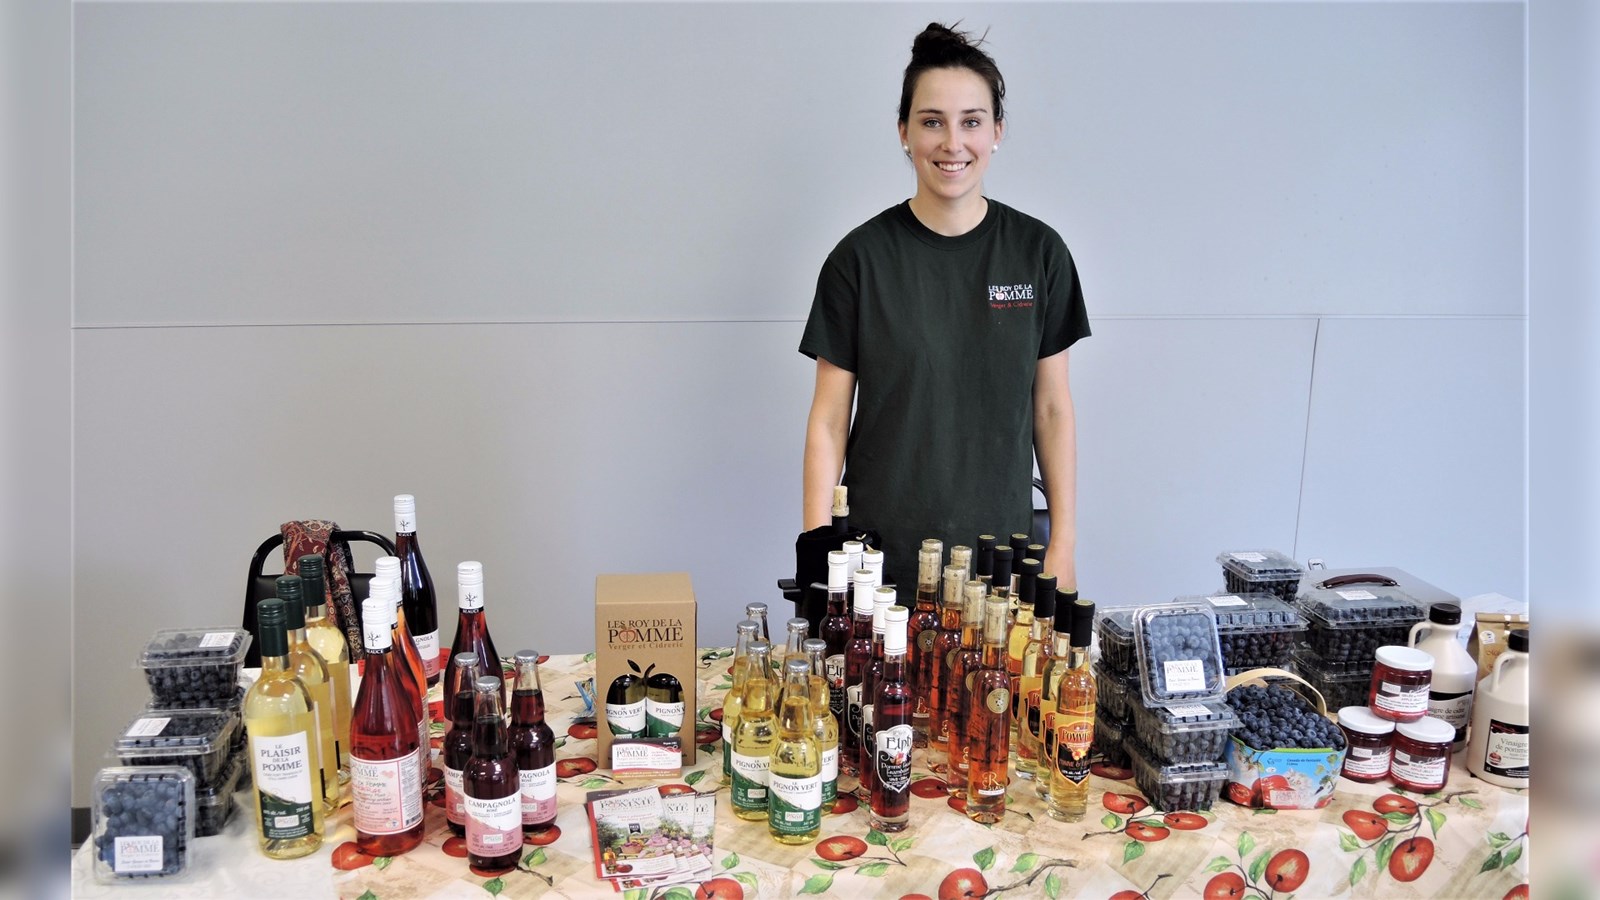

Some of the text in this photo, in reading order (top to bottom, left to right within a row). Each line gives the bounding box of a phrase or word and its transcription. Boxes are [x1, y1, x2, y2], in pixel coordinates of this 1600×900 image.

[989, 289, 1034, 301] POMME
[607, 618, 683, 629] LES ROY DE LA
[608, 627, 684, 644] POMME
[608, 643, 635, 651] Verger
[649, 641, 684, 649] Cidrerie
[629, 706, 643, 714] VERT
[655, 706, 681, 714] PIGNON
[261, 745, 302, 758] PLAISIR
[262, 759, 303, 771] POMME
[735, 759, 762, 769] PIGNON
[773, 780, 818, 791] PIGNON VERT
